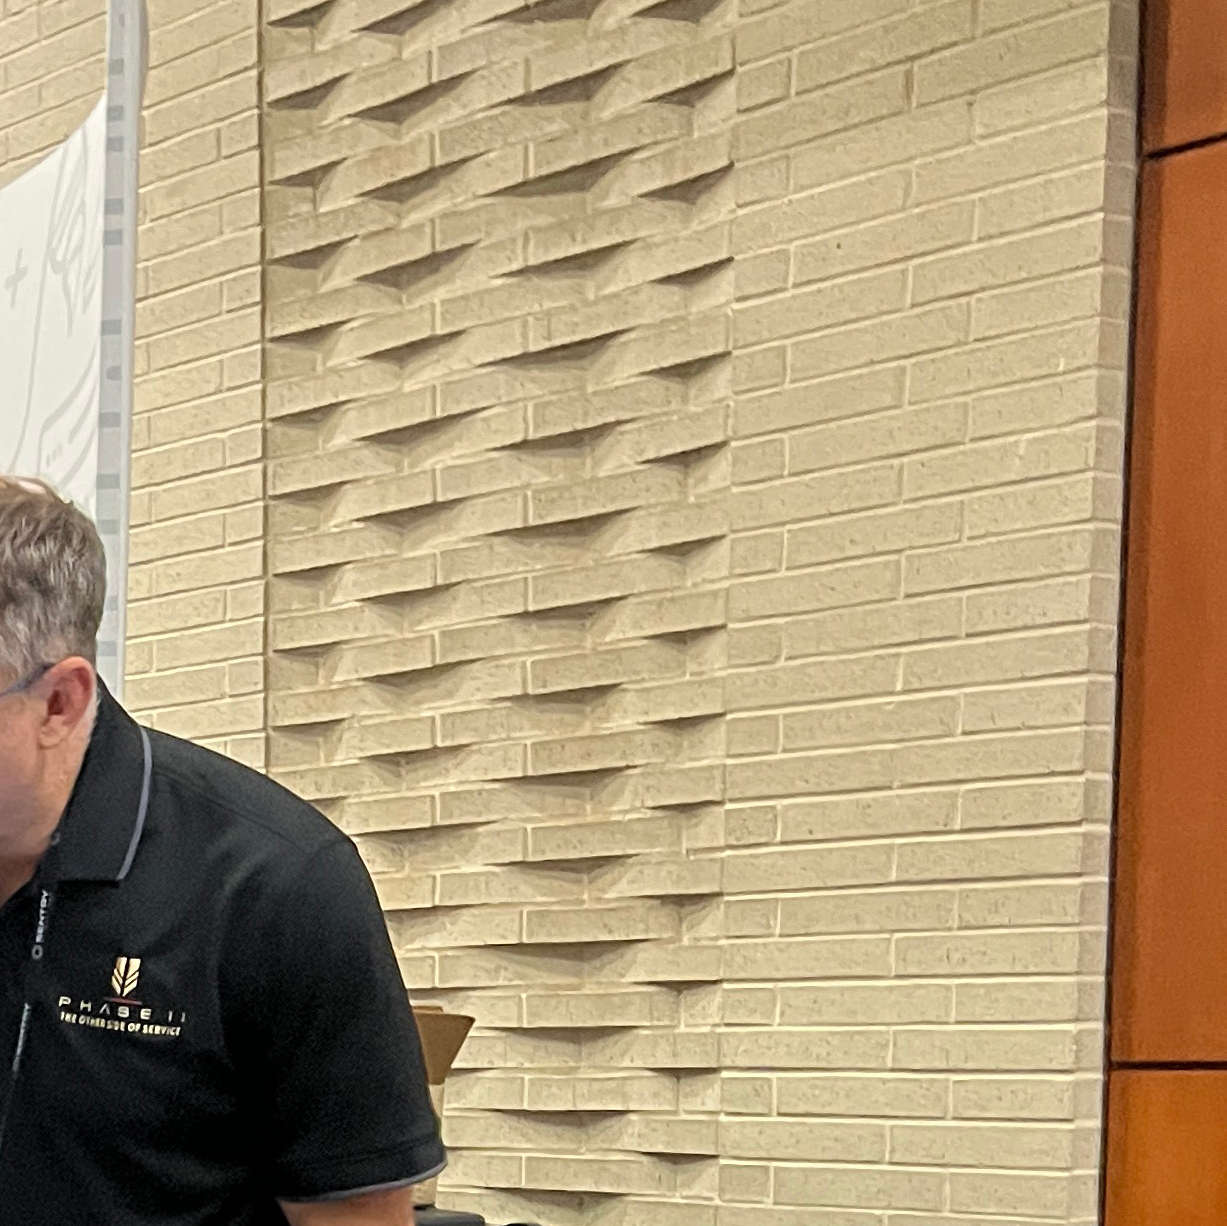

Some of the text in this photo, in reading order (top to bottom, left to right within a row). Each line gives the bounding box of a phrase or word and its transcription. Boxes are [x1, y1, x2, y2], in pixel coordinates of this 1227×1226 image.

[58, 996, 152, 1020] PHASE
[60, 1011, 77, 1024] THE
[78, 1015, 106, 1029] OTHER
[127, 1022, 141, 1033] OF
[142, 1024, 182, 1036] SERVICE
